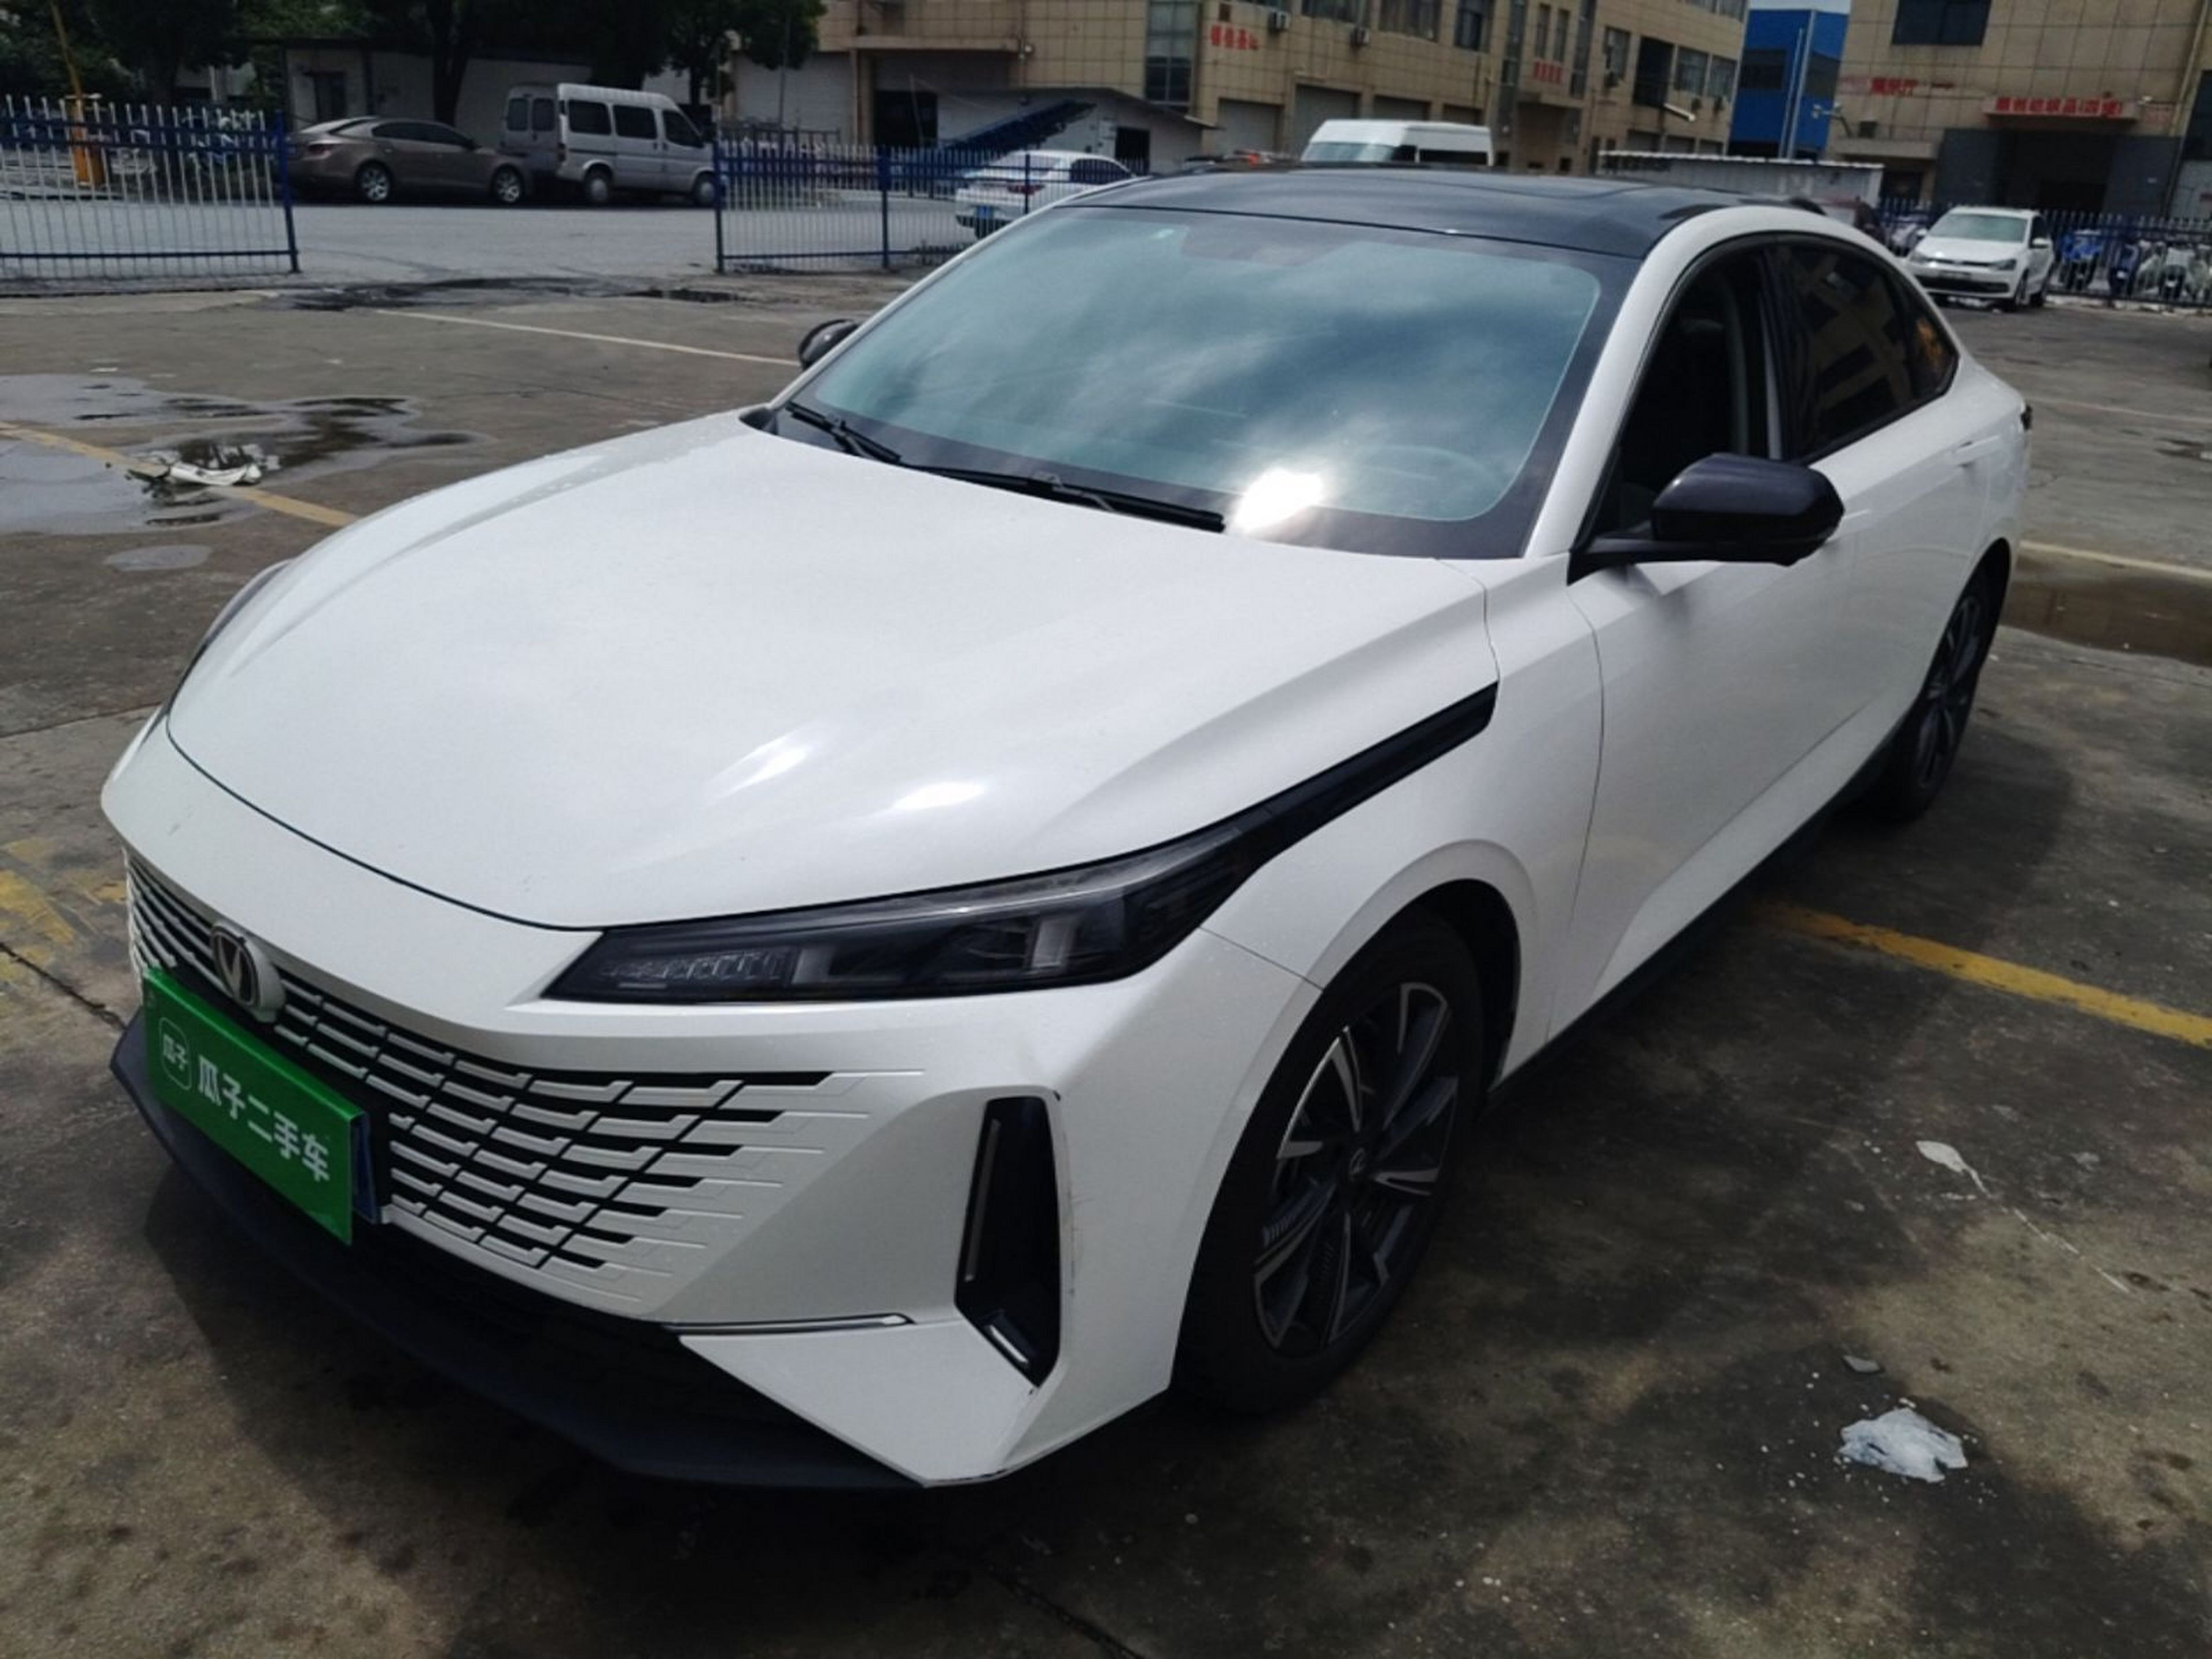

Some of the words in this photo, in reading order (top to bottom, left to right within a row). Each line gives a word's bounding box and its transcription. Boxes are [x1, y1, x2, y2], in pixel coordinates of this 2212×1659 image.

[198, 1055, 330, 1182] 瓜子二手车
